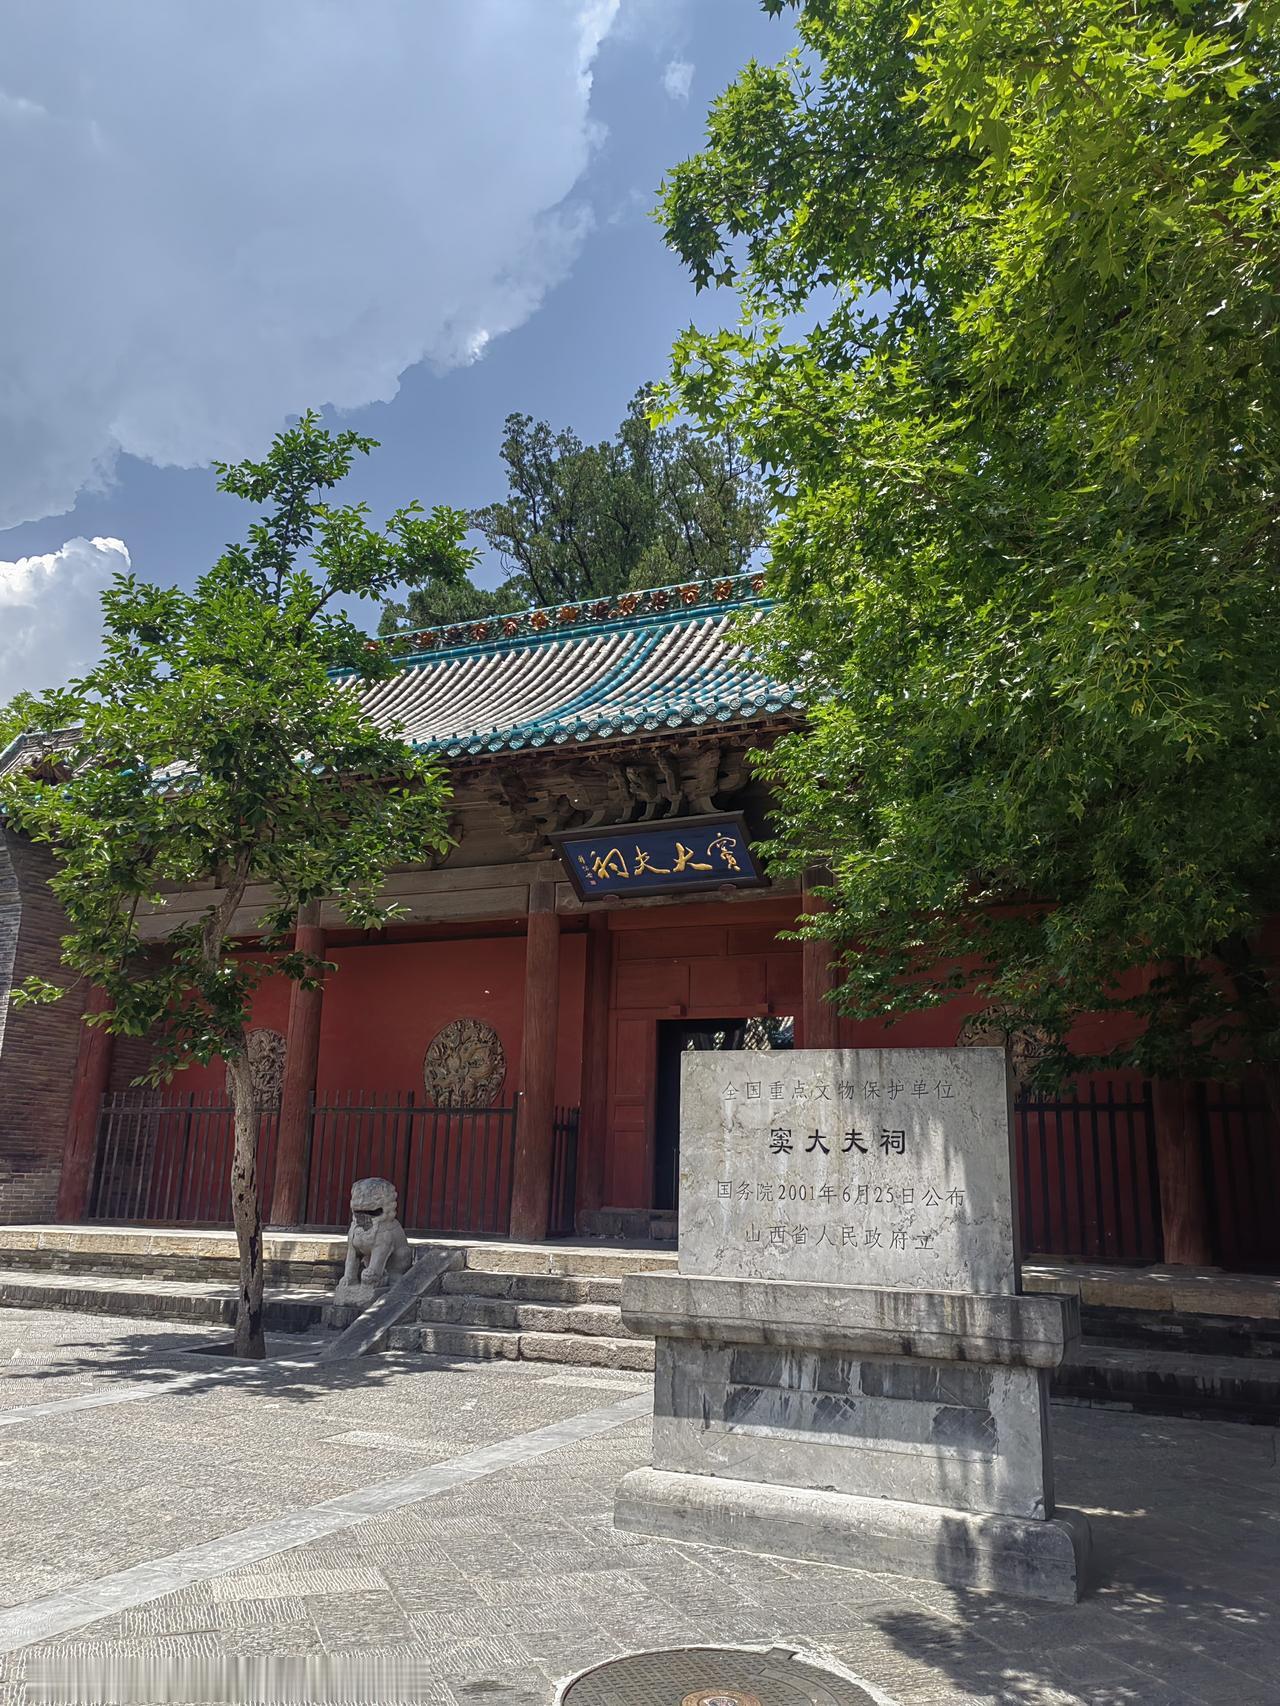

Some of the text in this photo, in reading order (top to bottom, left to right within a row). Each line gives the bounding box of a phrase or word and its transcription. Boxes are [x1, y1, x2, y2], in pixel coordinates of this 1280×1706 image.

[721, 1080, 955, 1101] 全国重点文物保护单位
[769, 1127, 906, 1155] 窦大夫祠
[716, 1180, 966, 1208] 国务院2001年6月25日公布
[745, 1224, 935, 1251] 山西省人民政府立
